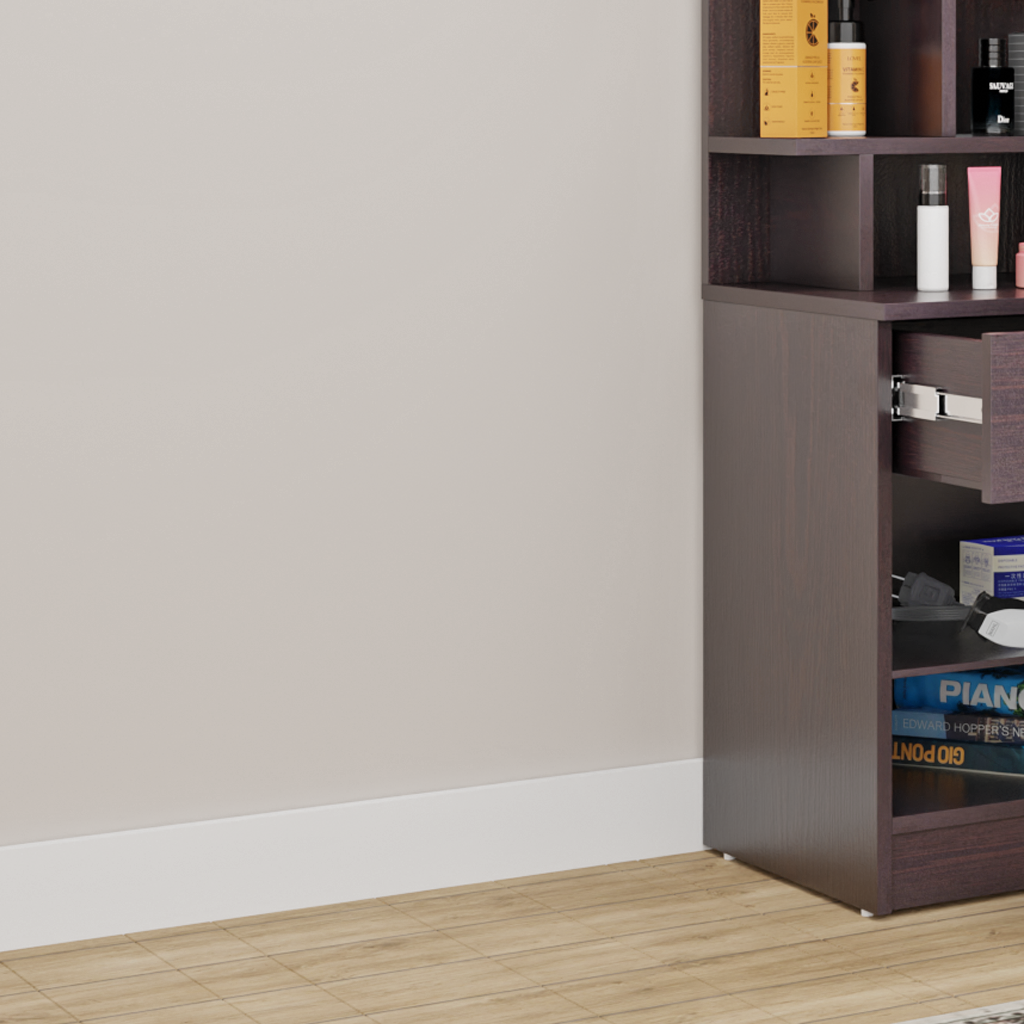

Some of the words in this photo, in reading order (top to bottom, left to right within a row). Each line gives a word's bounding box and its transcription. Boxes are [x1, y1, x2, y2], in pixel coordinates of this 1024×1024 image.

[997, 114, 1010, 124] Dior
[903, 718, 951, 732] EDWARD
[954, 722, 1009, 736] HOPPER'S
[937, 745, 965, 765] GIO
